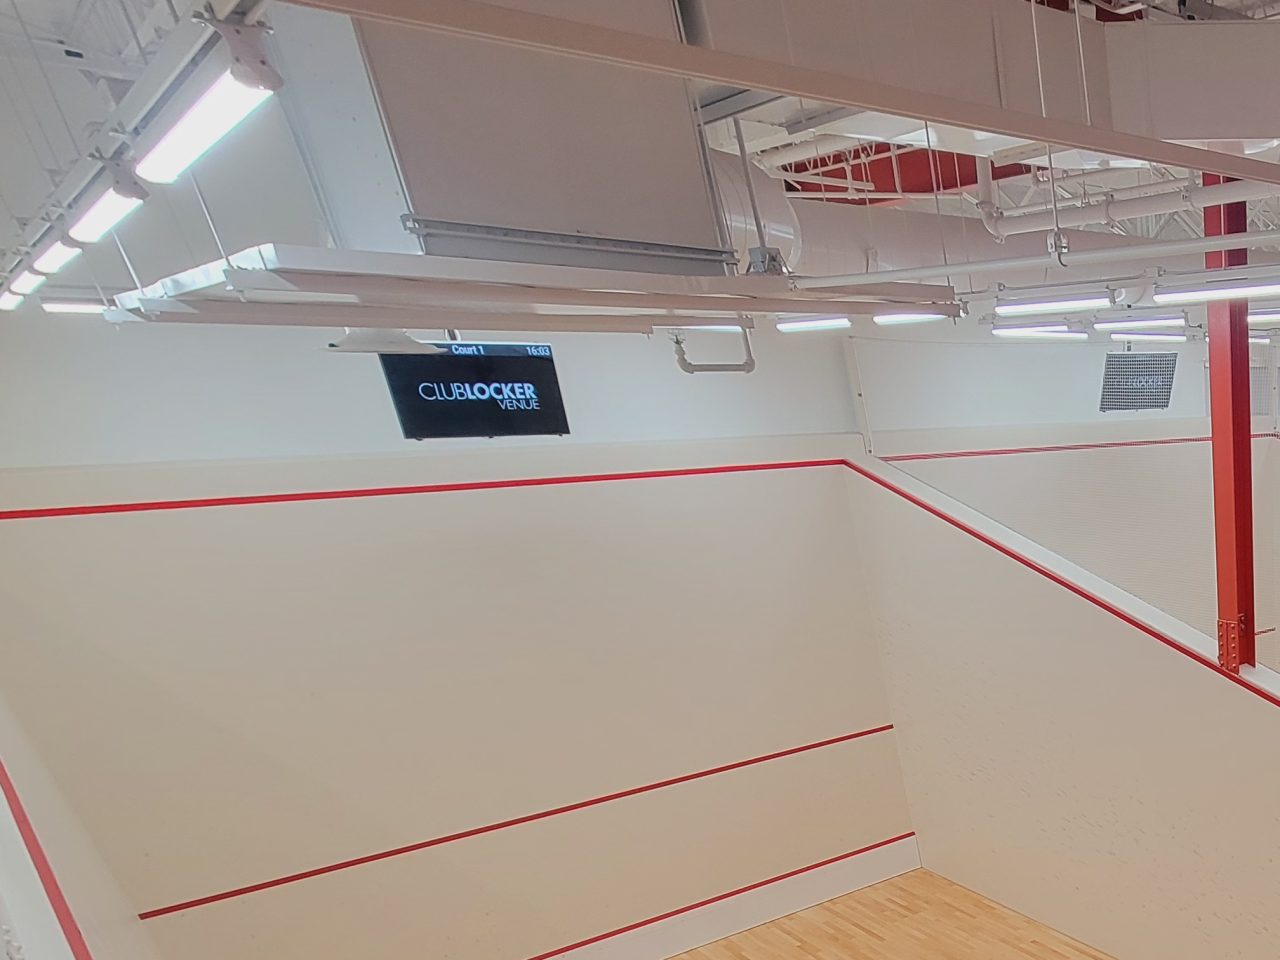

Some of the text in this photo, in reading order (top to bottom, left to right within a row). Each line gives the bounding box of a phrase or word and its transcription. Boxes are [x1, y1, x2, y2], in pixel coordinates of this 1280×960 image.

[452, 345, 485, 355] Court 1
[526, 346, 550, 356] 16:03
[418, 382, 537, 400] CLUBLOCKER
[497, 399, 541, 410] VENUE
